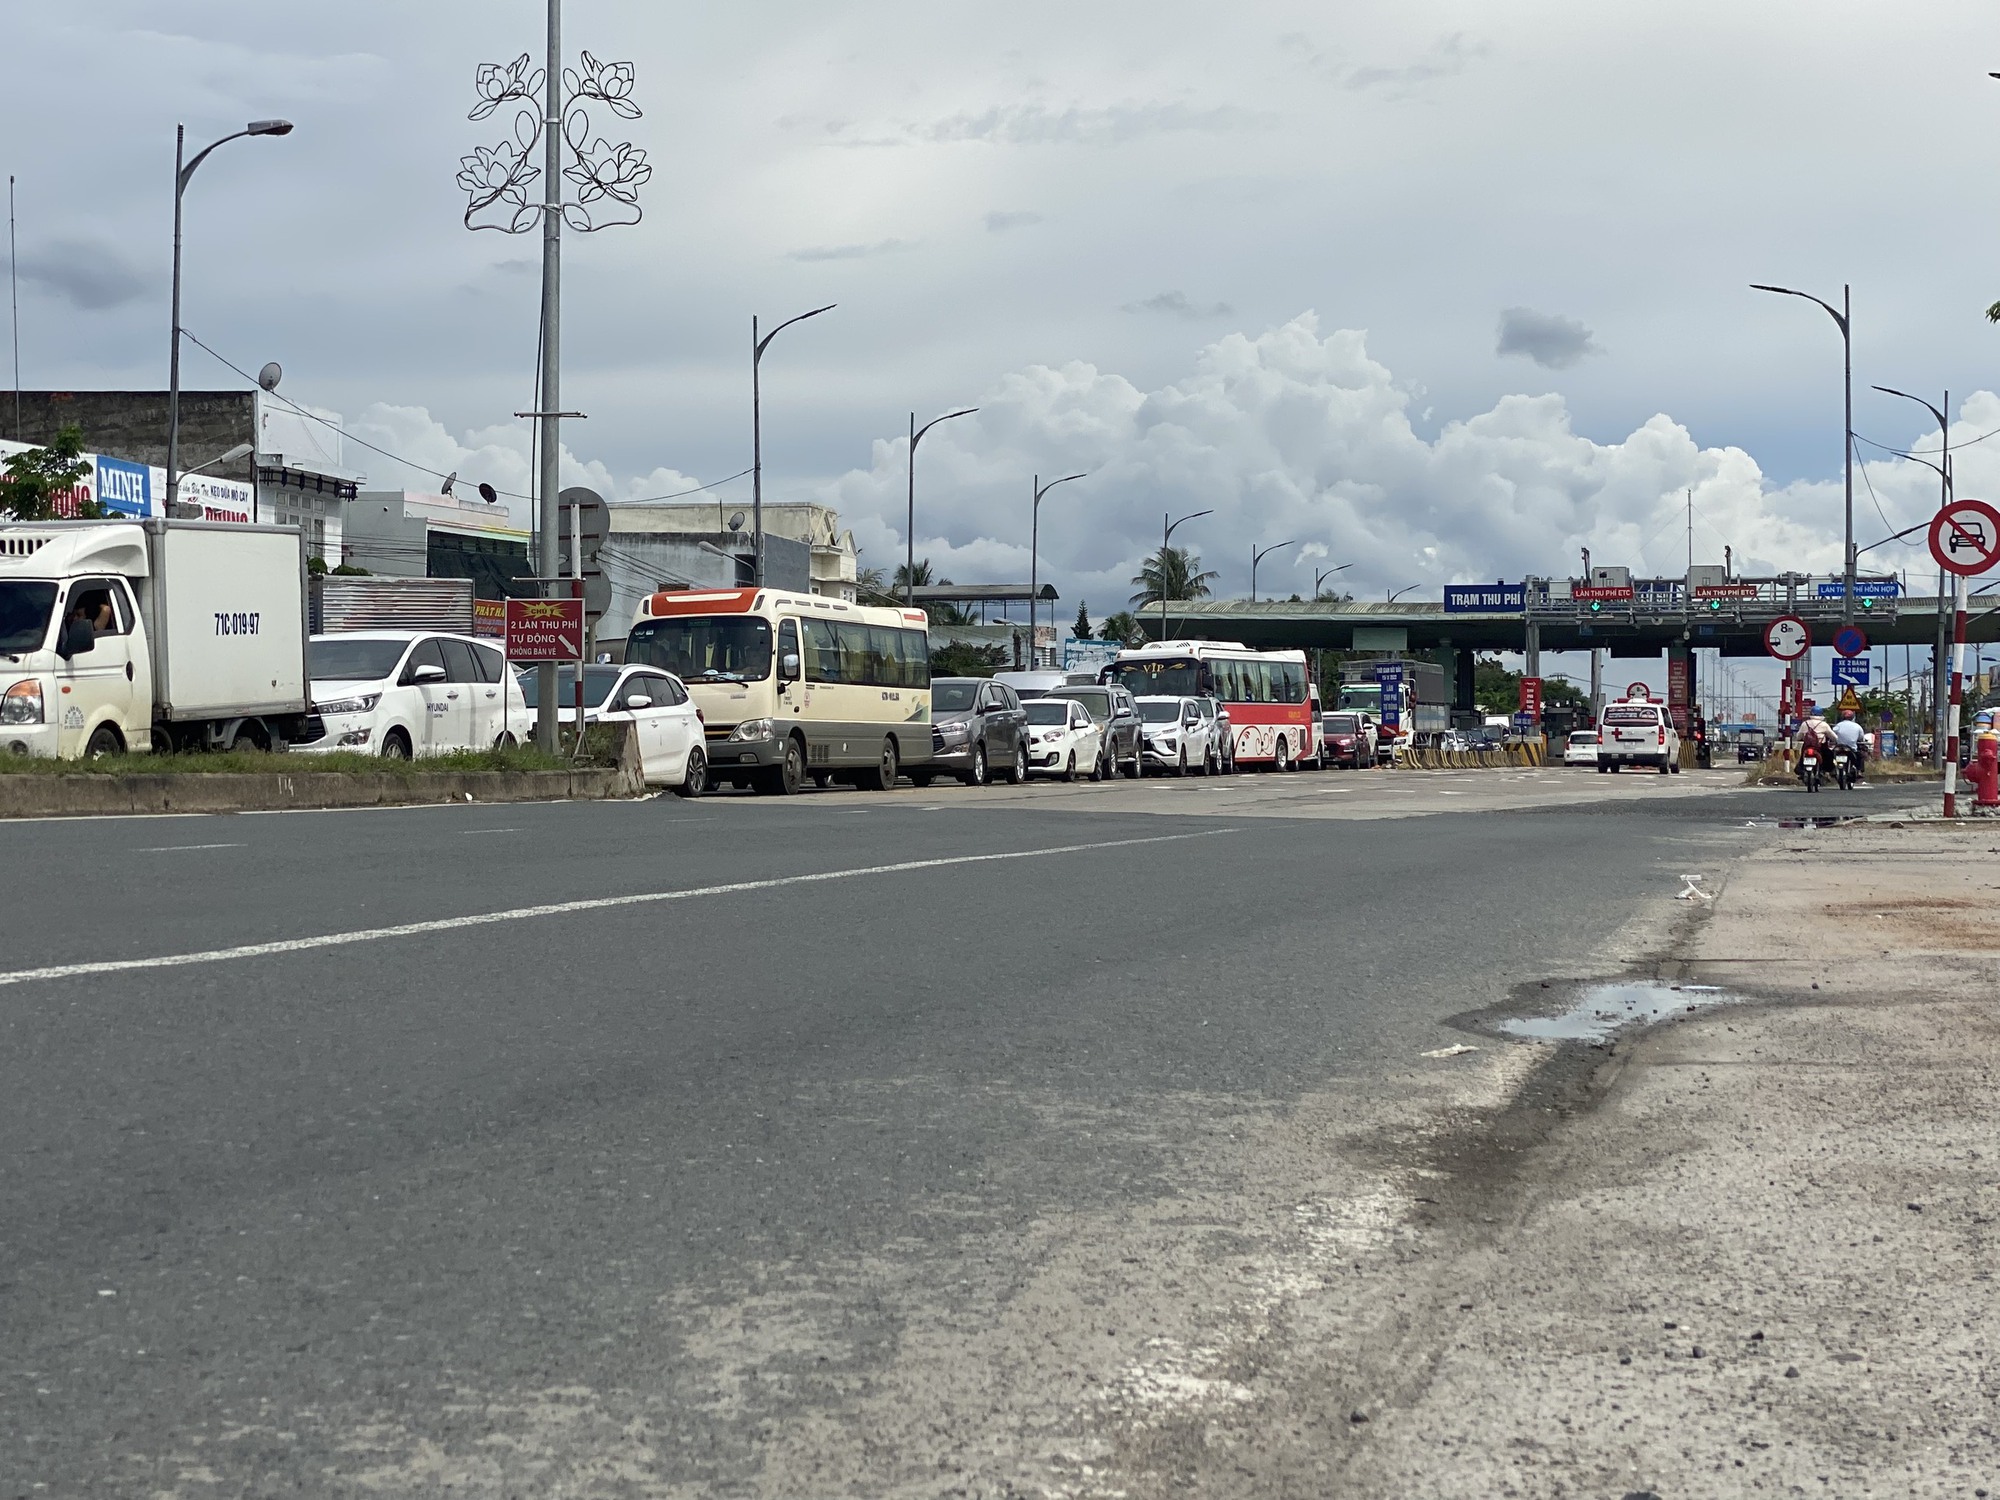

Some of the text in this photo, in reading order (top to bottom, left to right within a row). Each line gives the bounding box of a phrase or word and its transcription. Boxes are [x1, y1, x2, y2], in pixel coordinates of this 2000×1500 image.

[100, 466, 145, 505] MINH
[1575, 589, 1590, 597] LÀN
[1605, 588, 1617, 597] PHÍ
[1618, 589, 1631, 597] ETC
[1697, 588, 1712, 596] LÀN
[1728, 588, 1740, 596] PHÍ
[1820, 585, 1835, 593] LÀN
[1450, 593, 1480, 608] TRẠM
[1481, 593, 1502, 606] THU
[1504, 591, 1521, 605] PHÍ
[511, 621, 516, 629] 2
[518, 619, 538, 629] LÀN
[540, 620, 559, 629] THU
[562, 618, 578, 629] PHÍ
[1780, 623, 1794, 633] 8m
[511, 634, 524, 644] TỰ
[527, 633, 556, 645] ĐỘNG
[509, 646, 532, 656] KHÔNG
[1142, 662, 1165, 673] VIP
[426, 702, 449, 712] HYUNDAI
